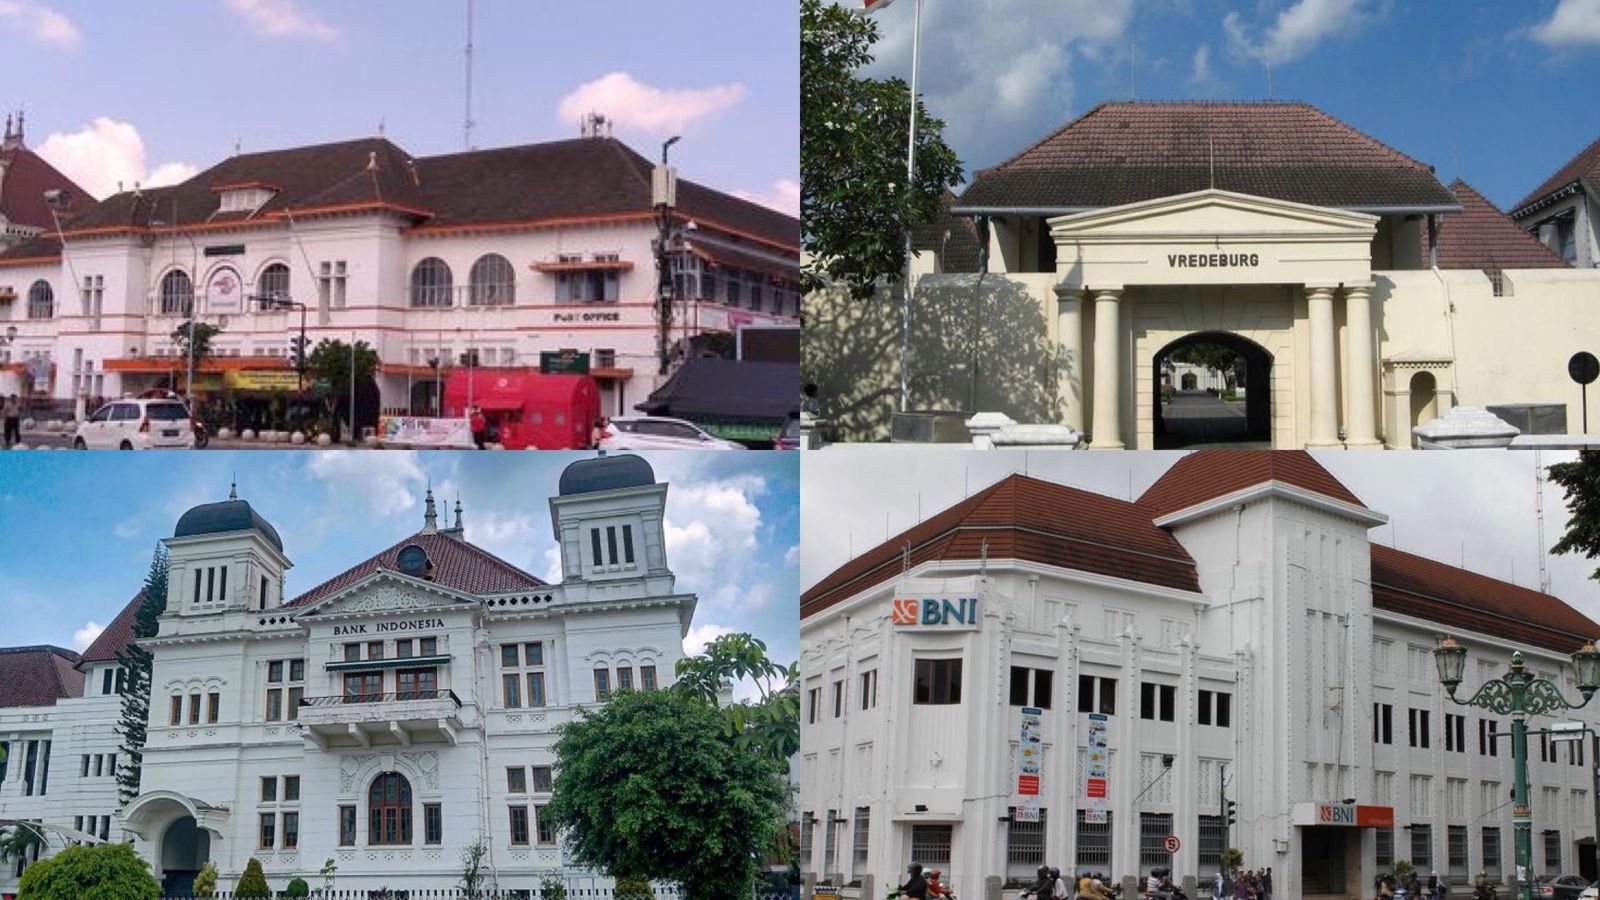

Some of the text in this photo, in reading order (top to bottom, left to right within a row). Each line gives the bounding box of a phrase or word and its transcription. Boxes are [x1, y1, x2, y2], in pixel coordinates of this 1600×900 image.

[1167, 254, 1259, 268] VREDEBURG
[583, 313, 619, 322] OFFICE
[921, 599, 977, 626] BNI
[334, 618, 444, 635] BANK INDONESIA
[1024, 812, 1038, 821] BNI
[1333, 806, 1353, 823] BNI
[1168, 839, 1176, 850] S
